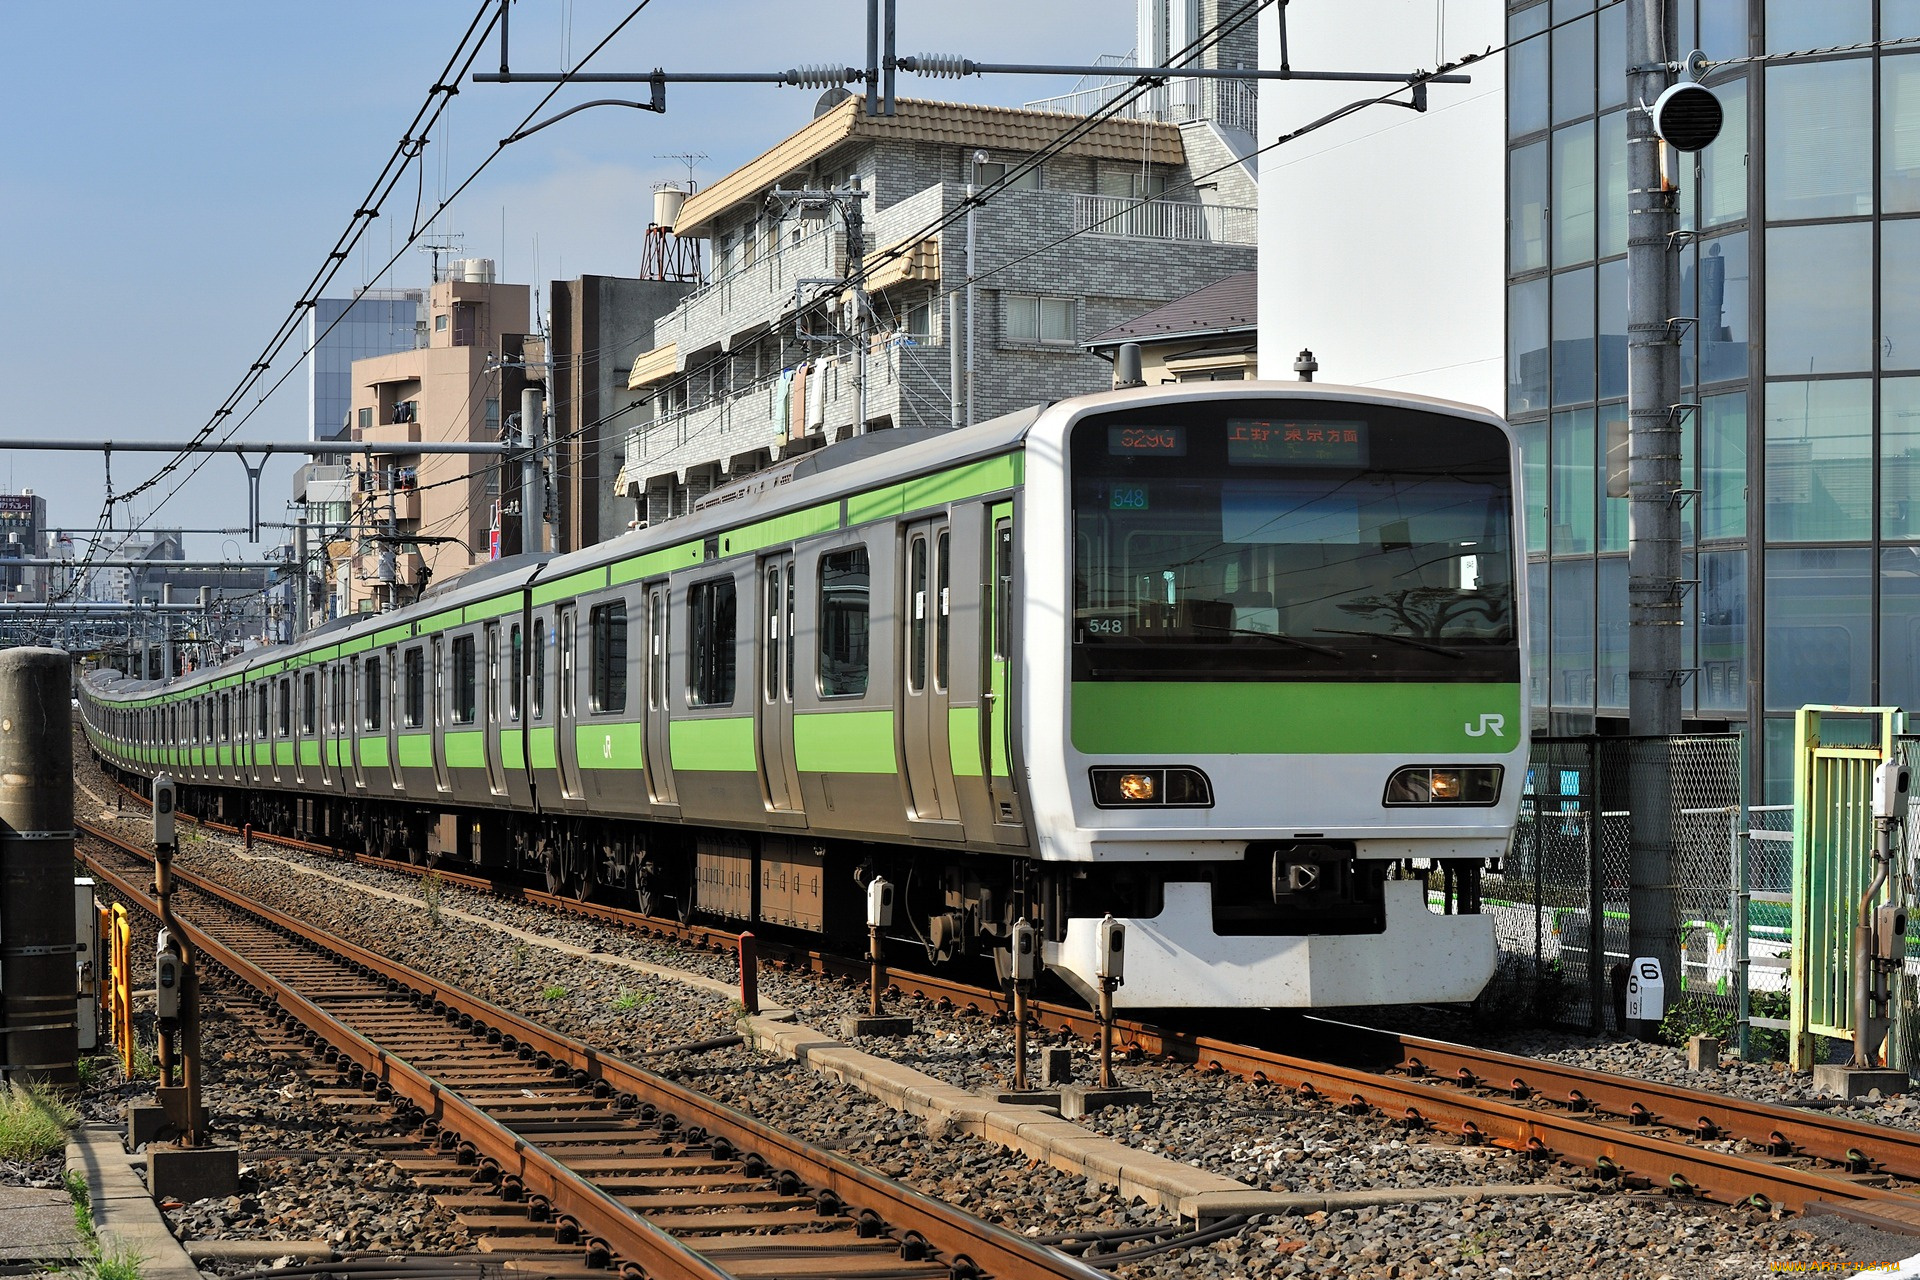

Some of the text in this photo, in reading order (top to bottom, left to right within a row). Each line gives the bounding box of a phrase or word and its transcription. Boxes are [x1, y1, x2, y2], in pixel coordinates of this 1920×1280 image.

[1114, 488, 1145, 507] 548
[1089, 619, 1122, 634] 548
[1464, 713, 1505, 737] JR
[603, 735, 612, 759] JR
[1641, 964, 1659, 979] 6
[1630, 975, 1638, 994] 6
[1629, 1002, 1638, 1015] 19
